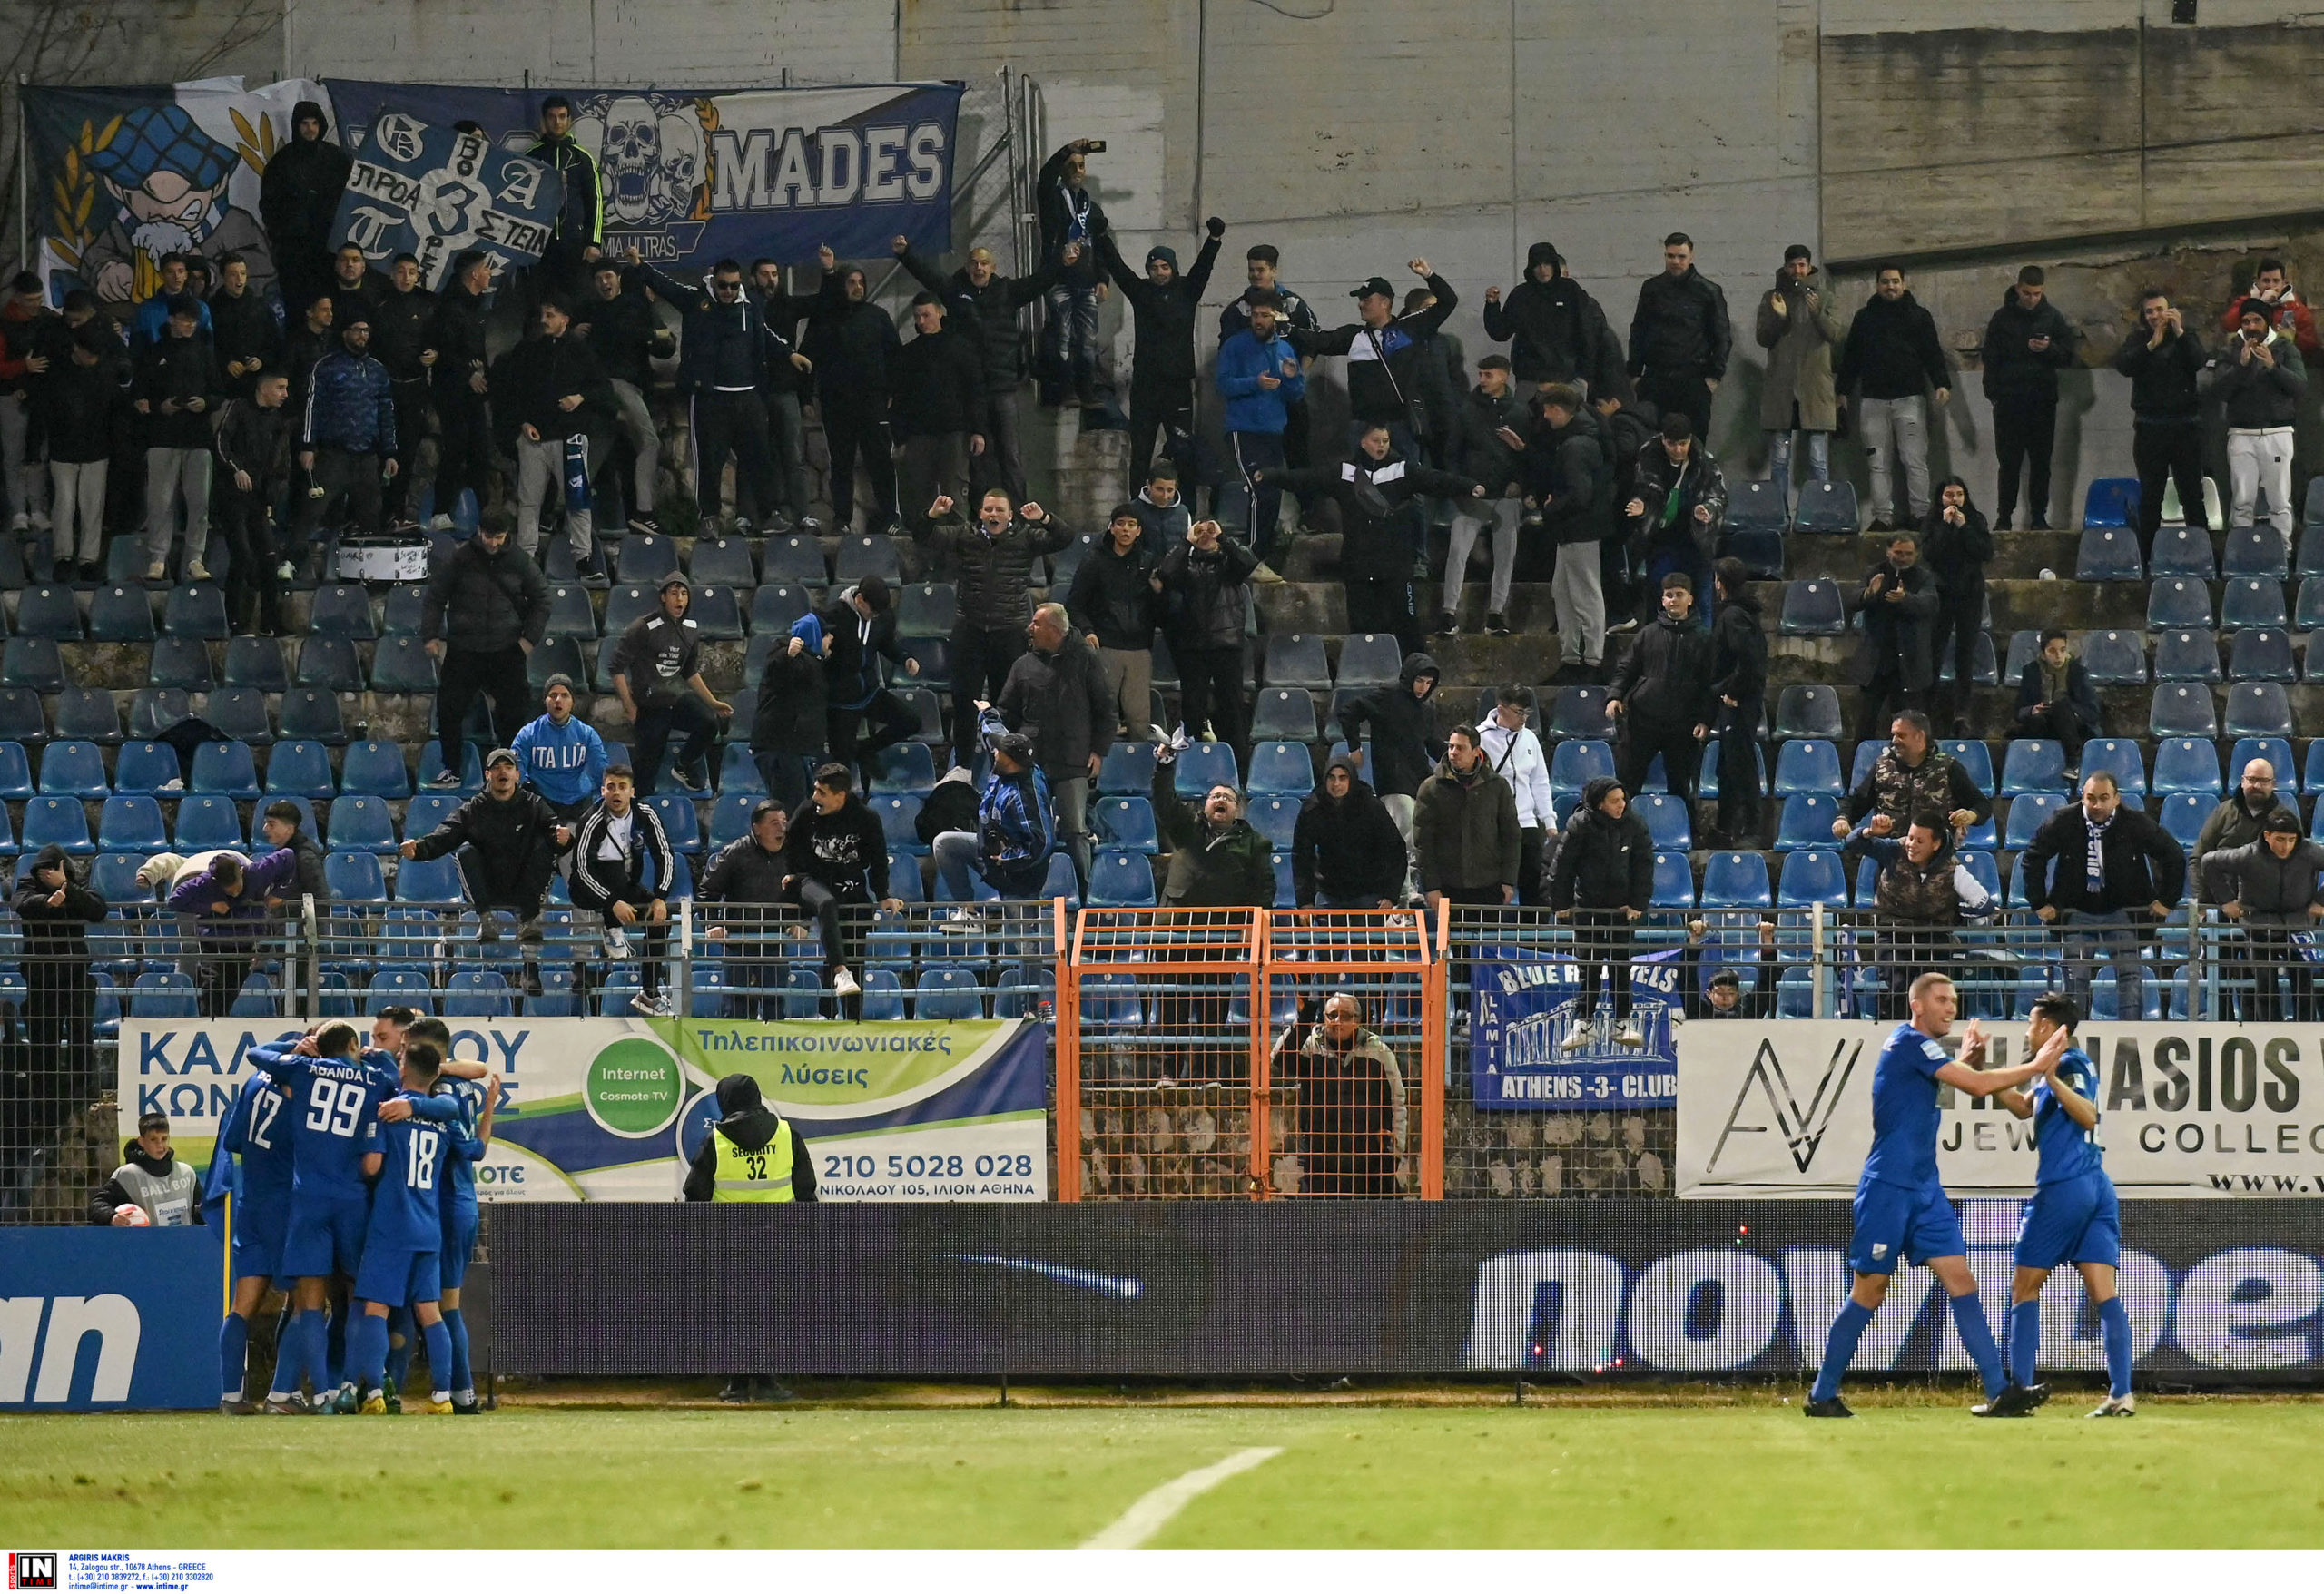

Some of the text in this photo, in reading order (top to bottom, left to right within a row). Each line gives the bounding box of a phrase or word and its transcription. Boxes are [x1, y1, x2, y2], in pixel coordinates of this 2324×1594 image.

[712, 124, 946, 211] MADES
[1497, 965, 1560, 996] BLUE
[697, 1029, 952, 1056] Τηλεπικοινωνιακές
[602, 1067, 666, 1081] Internet
[781, 1063, 869, 1088] λύσεις
[1502, 1075, 1582, 1099] ATHENS
[1621, 1074, 1678, 1098] CLUB
[306, 1077, 366, 1138] 99
[599, 1092, 669, 1101] Cosmote TV
[248, 1087, 283, 1150] 12
[406, 1128, 438, 1190] 18
[746, 1156, 768, 1181] 32
[824, 1154, 1033, 1178] 210 5028 028
[141, 1184, 171, 1198] BALL
[901, 1184, 930, 1196] 105,
[980, 1183, 1035, 1195] ΑΘΗΝΑ
